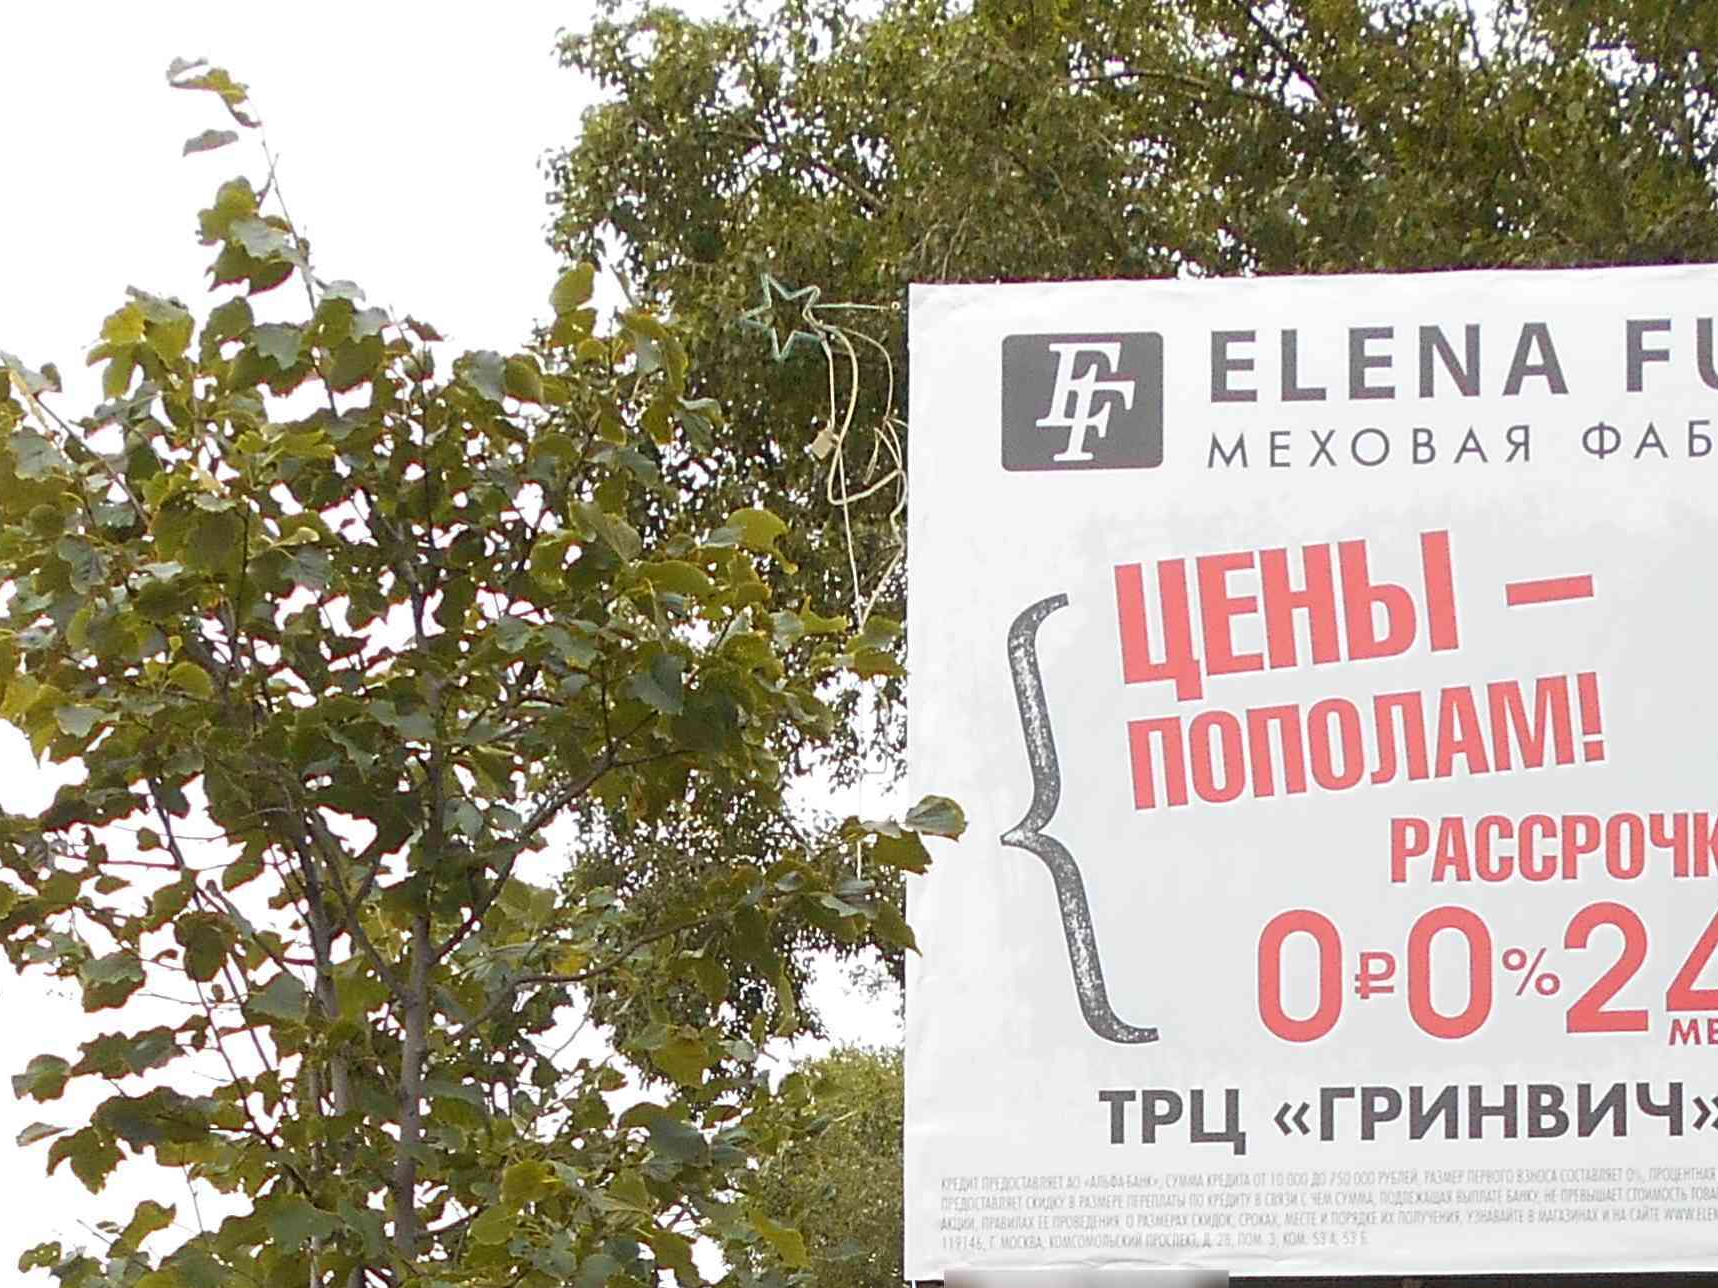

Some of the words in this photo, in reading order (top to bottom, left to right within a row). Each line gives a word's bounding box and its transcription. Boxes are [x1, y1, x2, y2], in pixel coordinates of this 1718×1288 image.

[1210, 322, 1569, 403] ELENA
[1207, 424, 1531, 468] МЕХОВАЯ
[1113, 529, 1460, 702] ЦЕНЫ
[1126, 671, 1605, 810] ПОПОЛАМ!
[1098, 1087, 1247, 1155] ТРЦ
[1207, 1172, 1249, 1189] КРЕДИТА
[1287, 1172, 1308, 1186] 000
[1310, 1172, 1326, 1188] ДО
[1354, 1171, 1375, 1185] 000
